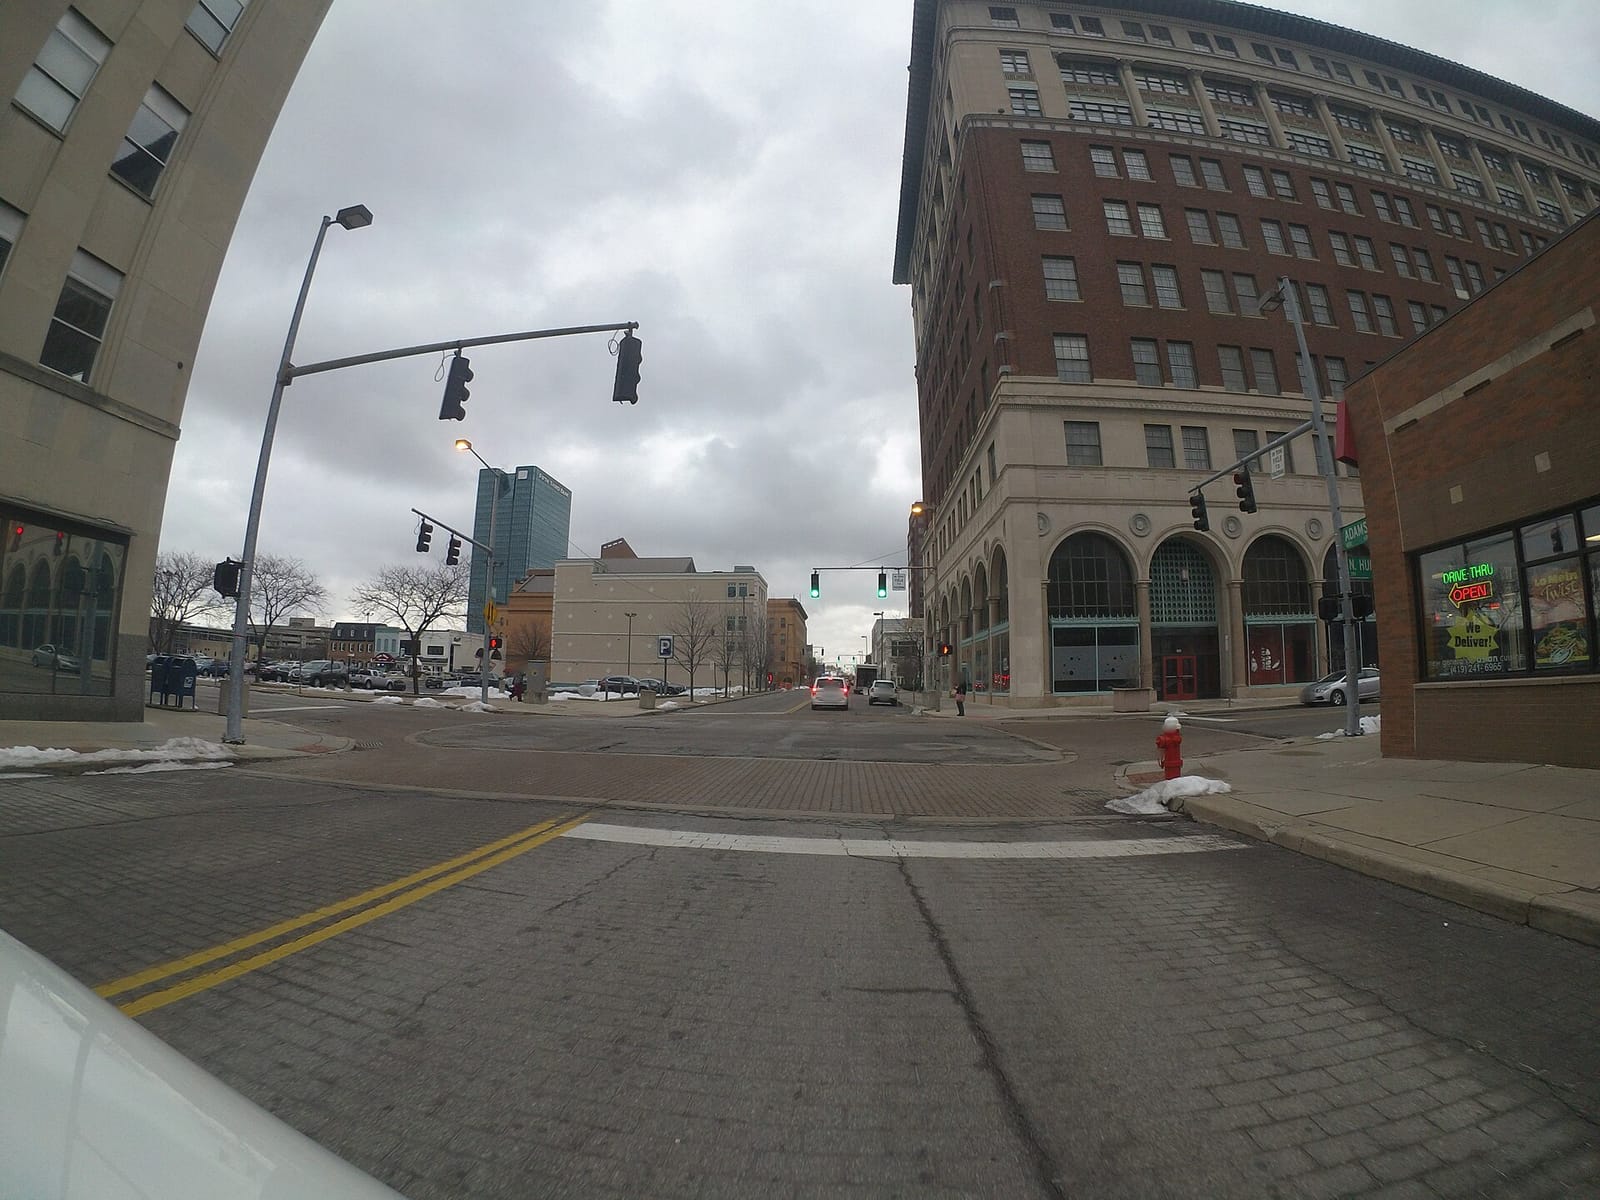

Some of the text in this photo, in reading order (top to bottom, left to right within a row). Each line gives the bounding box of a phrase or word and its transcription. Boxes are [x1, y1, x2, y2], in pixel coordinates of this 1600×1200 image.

[1344, 521, 1368, 542] ADAMS
[1442, 563, 1494, 584] DRIVE-THRU
[1453, 584, 1487, 601] OPEN
[1465, 621, 1480, 634] We
[1454, 635, 1492, 648] Deliver!
